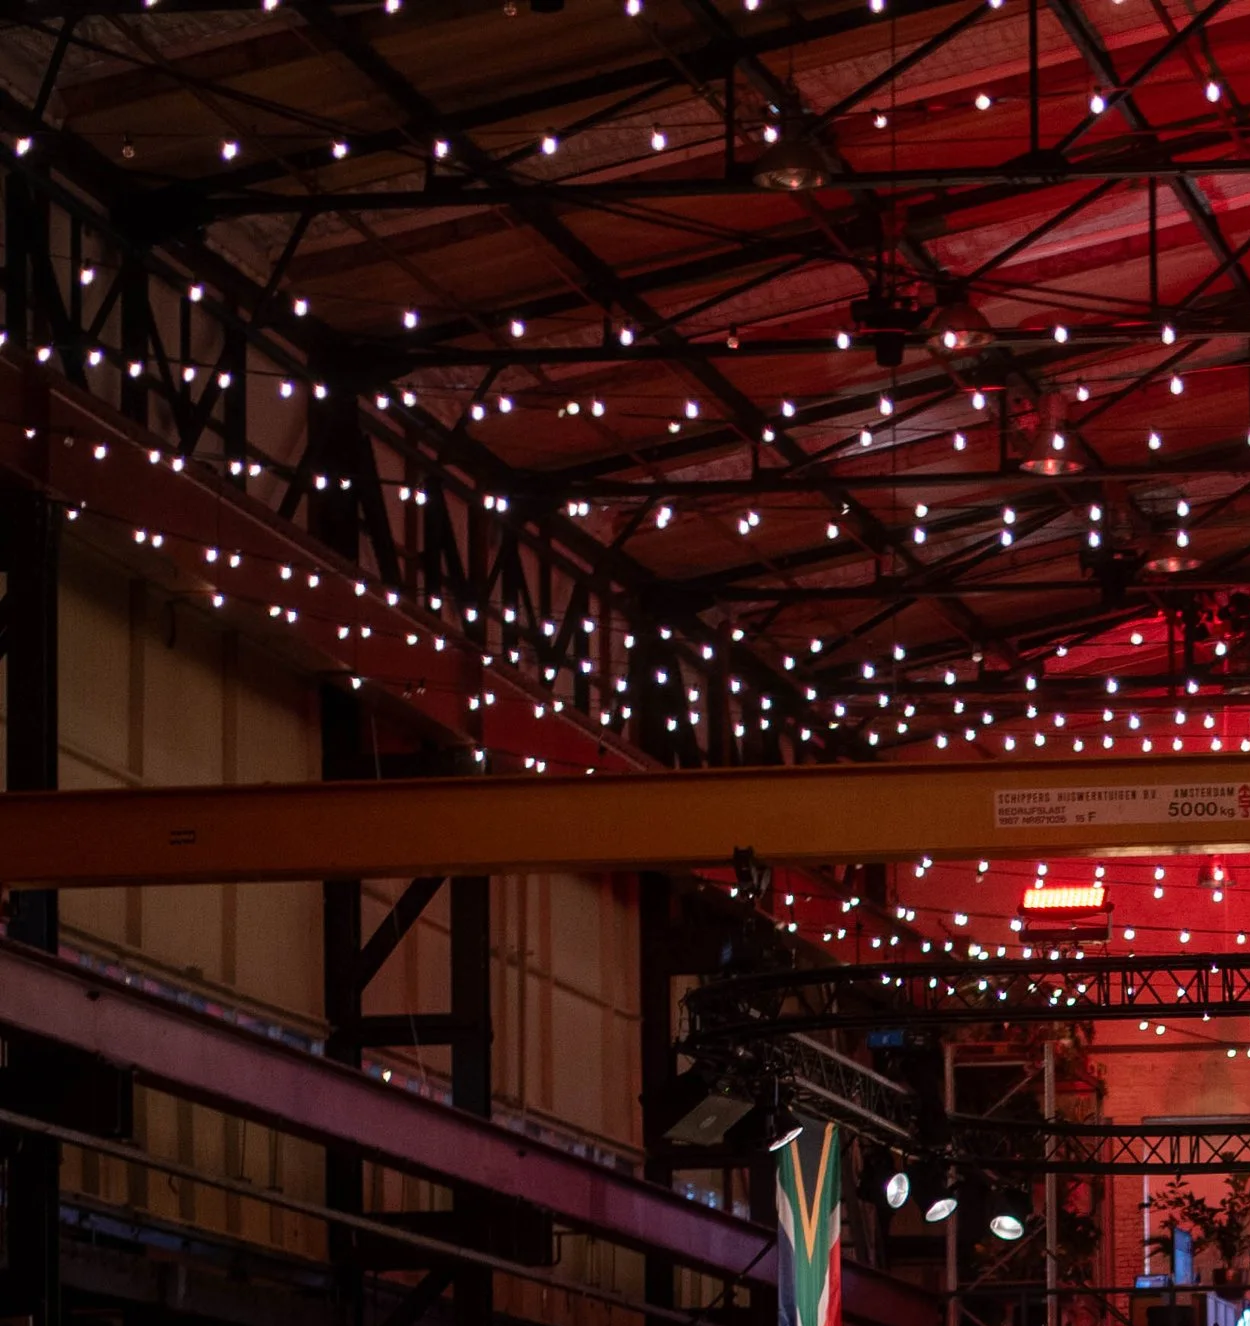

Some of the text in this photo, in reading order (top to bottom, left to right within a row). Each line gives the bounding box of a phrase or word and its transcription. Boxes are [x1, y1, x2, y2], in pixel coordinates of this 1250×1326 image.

[998, 791, 1050, 805] SCHIPPERS
[1174, 786, 1234, 798] AMSTERDAM
[998, 805, 1066, 816] BEDRIJFSLAST
[1087, 811, 1097, 822] F
[1168, 801, 1236, 818] 5000 kg
